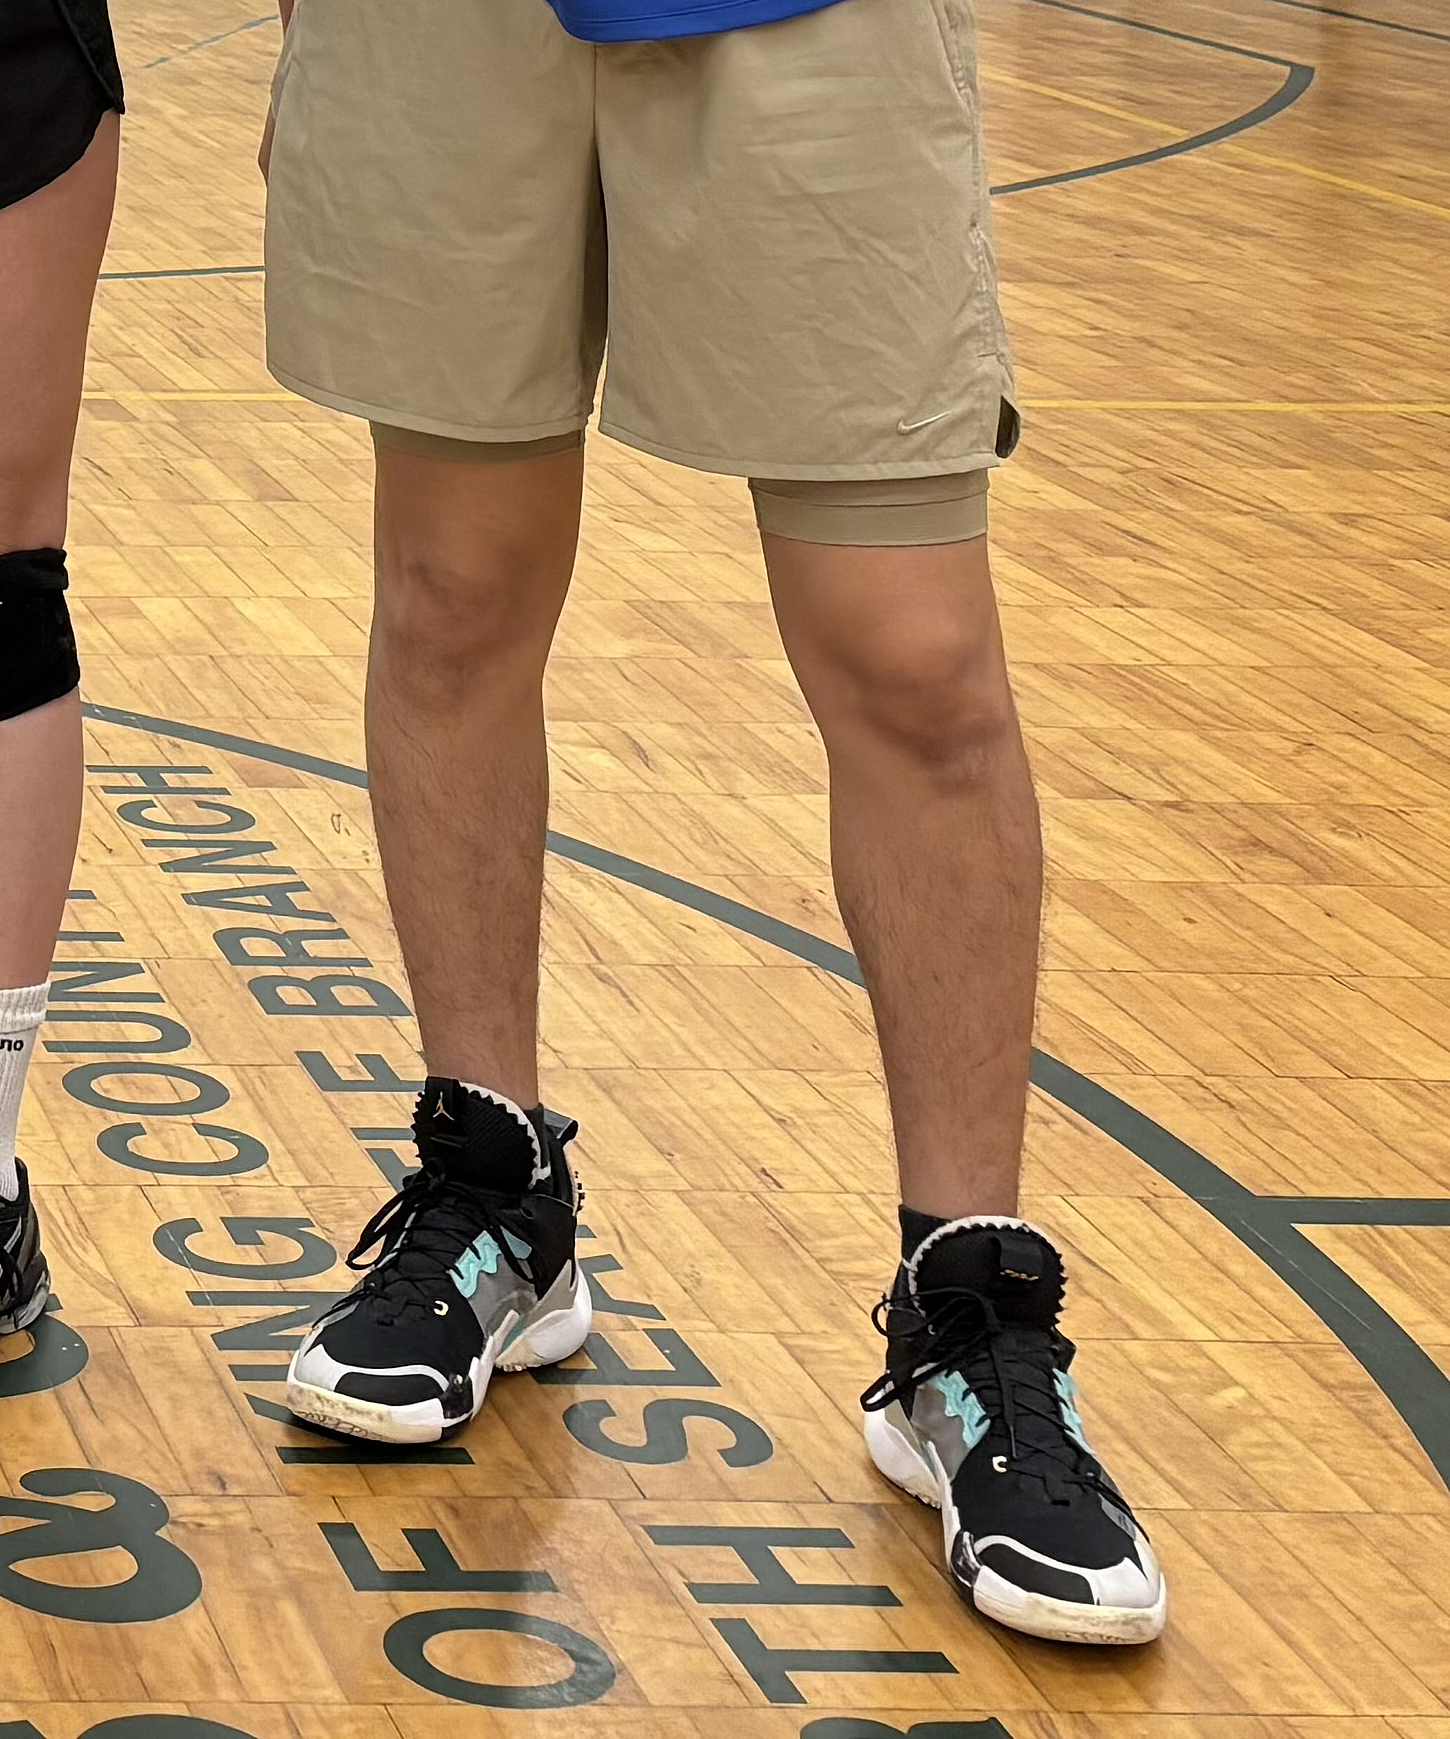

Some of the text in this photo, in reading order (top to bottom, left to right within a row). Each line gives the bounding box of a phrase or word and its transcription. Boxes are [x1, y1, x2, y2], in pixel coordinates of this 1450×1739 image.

[86, 765, 413, 1016] BRANCH
[42, 890, 269, 1176] COUN
[318, 1522, 616, 1709] OF
